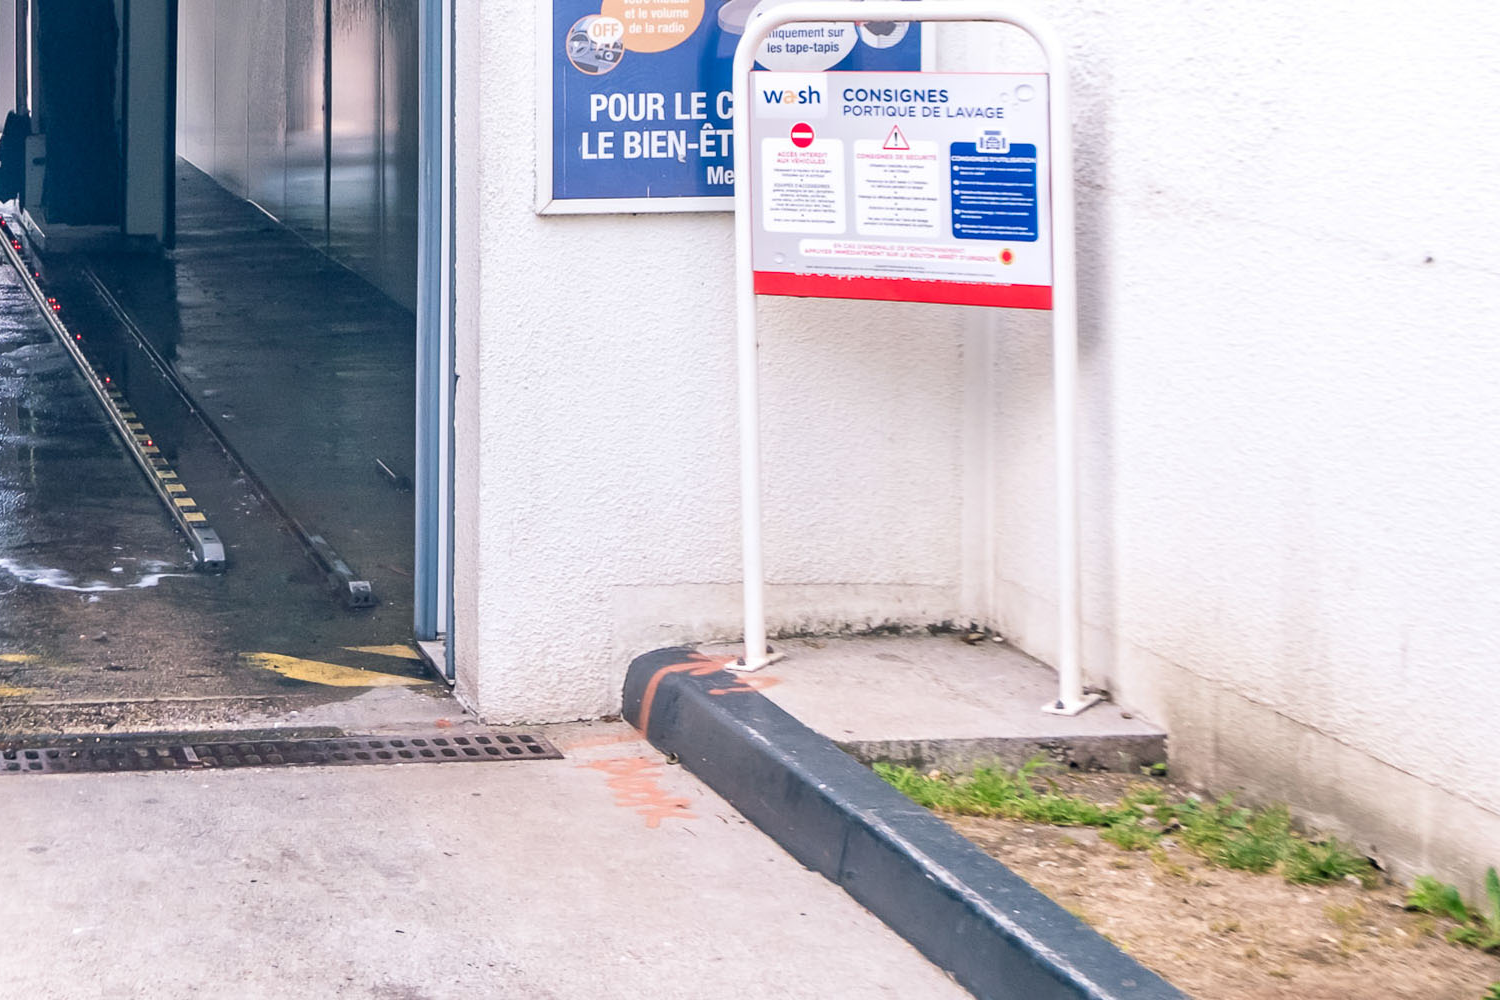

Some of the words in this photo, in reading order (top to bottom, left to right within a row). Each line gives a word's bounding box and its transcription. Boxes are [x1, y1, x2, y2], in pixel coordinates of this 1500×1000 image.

[625, 9, 635, 18] et
[638, 8, 648, 18] le
[651, 8, 689, 18] volume
[593, 24, 619, 37] OFF
[629, 23, 642, 33] de
[645, 23, 654, 33] la
[657, 22, 685, 33] radio
[767, 28, 824, 40] niquement
[828, 29, 844, 37] sur
[767, 43, 782, 53] les
[785, 42, 839, 54] tape-tapis
[763, 85, 821, 104] wash
[843, 88, 949, 103] CONSIGNES
[590, 93, 665, 122] POUR
[675, 92, 707, 120] LE
[843, 105, 916, 117] PORTIQUE
[922, 107, 940, 118] DE
[947, 107, 1004, 119] LAVAGE
[582, 132, 614, 159] LE
[624, 122, 734, 158] BIEN-ÊT
